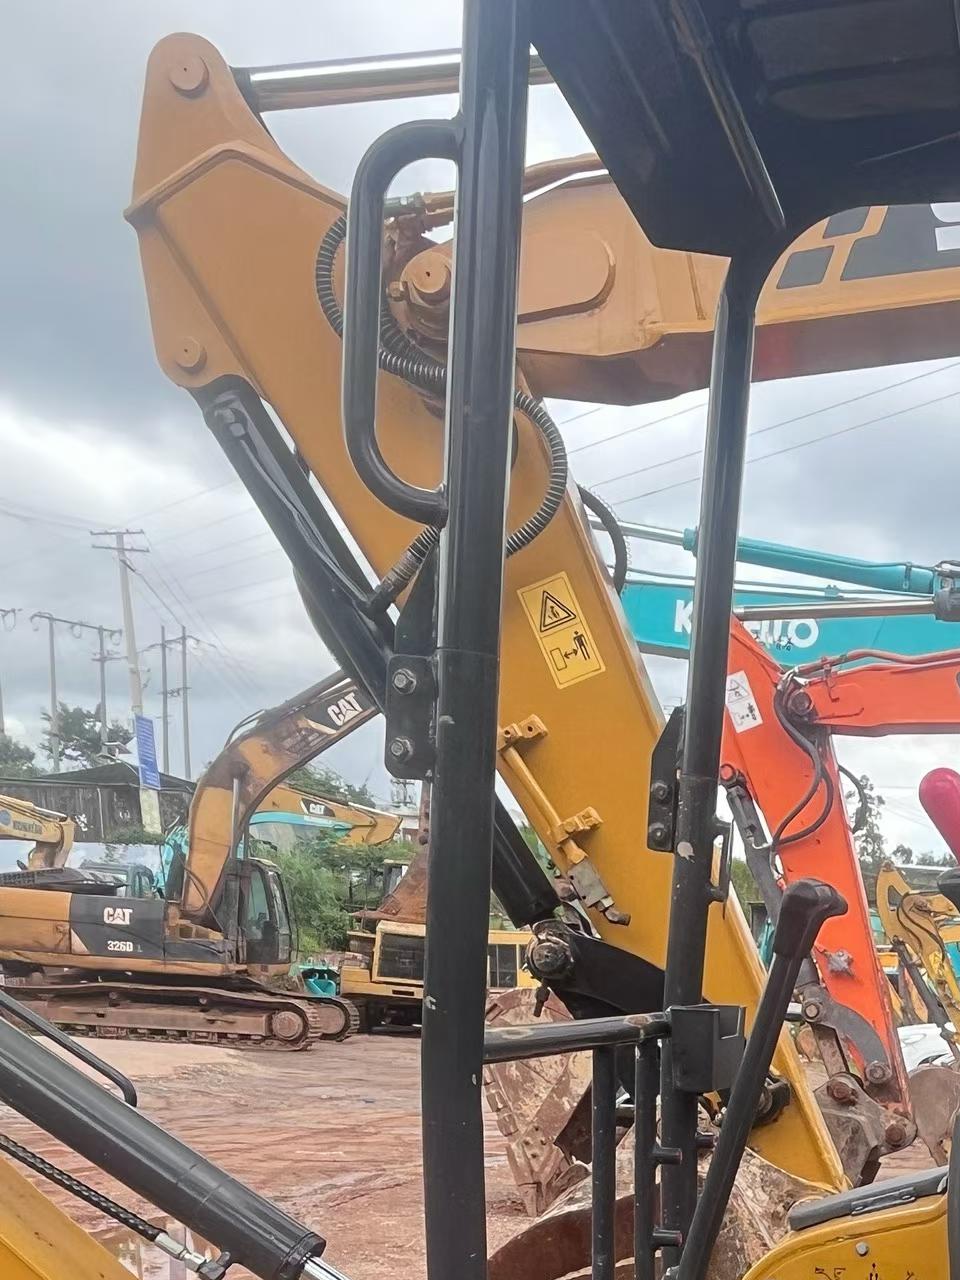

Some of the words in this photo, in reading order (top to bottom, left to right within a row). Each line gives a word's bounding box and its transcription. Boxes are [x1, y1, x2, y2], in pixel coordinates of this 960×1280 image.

[327, 692, 363, 726] CAT
[309, 803, 326, 815] CAT
[103, 907, 133, 925] CAT
[107, 940, 134, 952] 326D
